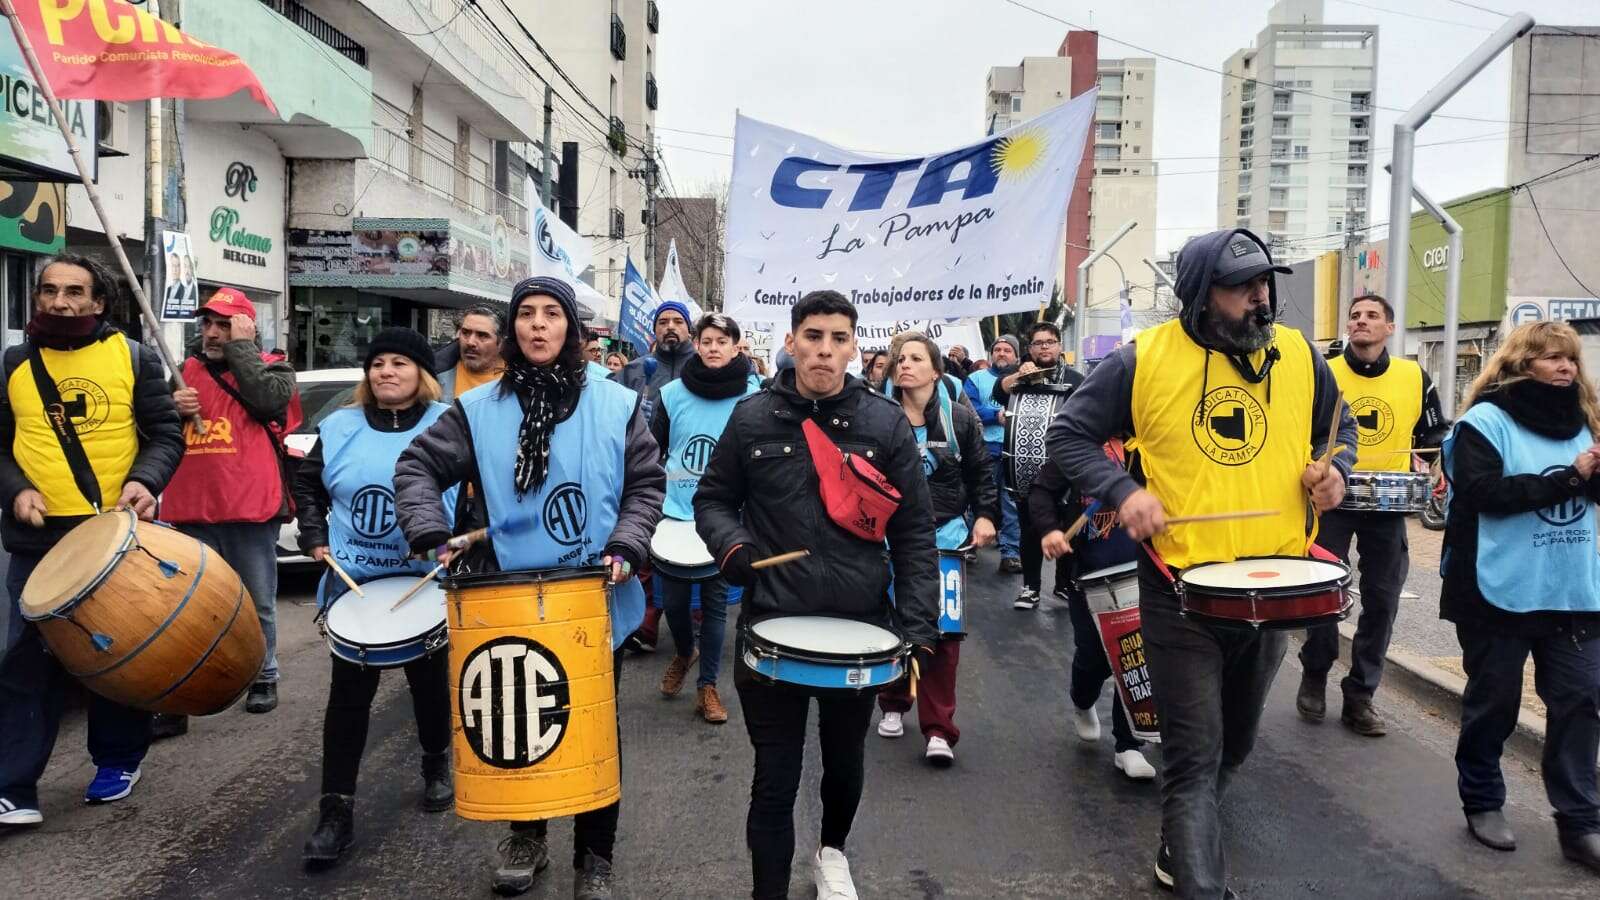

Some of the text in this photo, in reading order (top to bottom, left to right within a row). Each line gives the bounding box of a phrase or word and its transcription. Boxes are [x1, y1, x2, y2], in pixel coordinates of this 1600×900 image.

[53, 51, 97, 65] Partido
[101, 50, 169, 63] Comunista
[0, 72, 87, 138] ICEIA
[770, 137, 1008, 212] CTA
[816, 207, 996, 260] La Pampa
[754, 288, 802, 306] Central
[851, 286, 944, 307] Trabajadores
[948, 285, 966, 299] de
[969, 284, 982, 299] la
[857, 320, 911, 339] OLÍTICAS
[1195, 390, 1264, 427] SINDICATO VIAL
[1205, 442, 1257, 462] LA PAMPA
[353, 488, 394, 534] ATE
[346, 538, 400, 551] ARGENTINA
[355, 554, 412, 569] PAMPA
[1120, 632, 1143, 655] IGUA
[1122, 669, 1140, 689] POR
[463, 644, 562, 763] ATE
